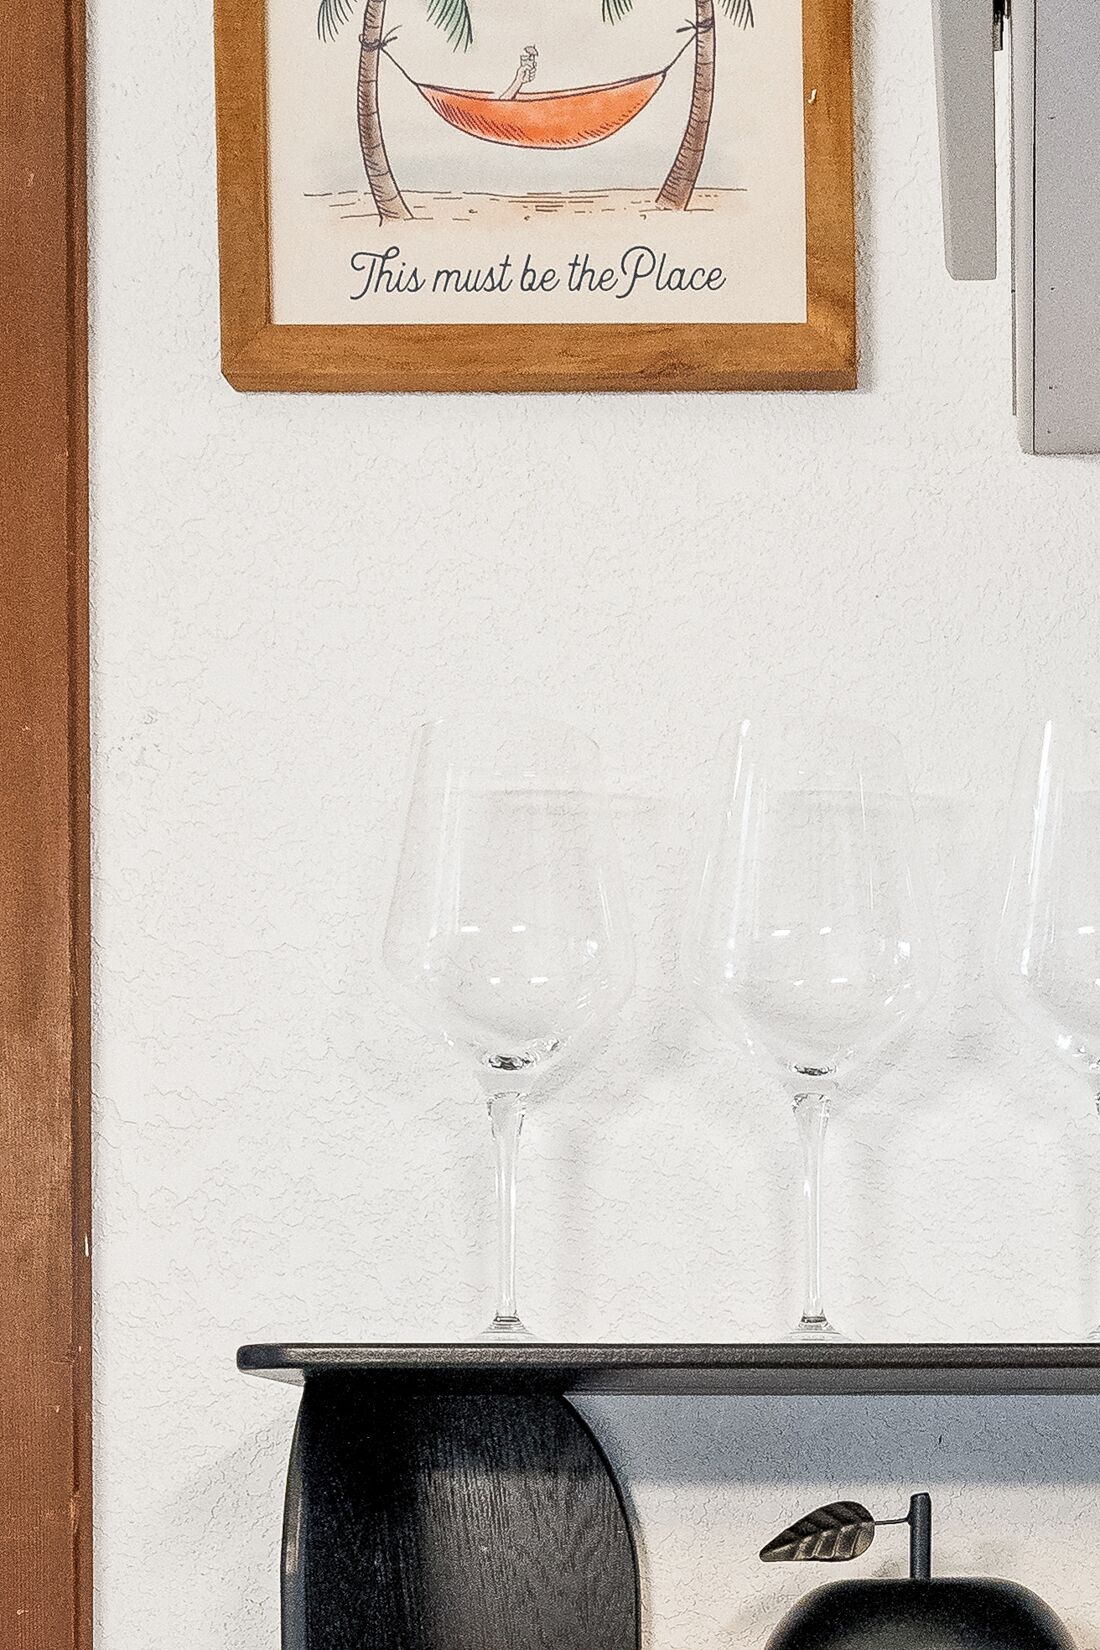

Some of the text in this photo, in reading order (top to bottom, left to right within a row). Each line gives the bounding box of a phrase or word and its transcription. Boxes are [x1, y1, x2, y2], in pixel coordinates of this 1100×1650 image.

[350, 246, 727, 300] This must be the Place
